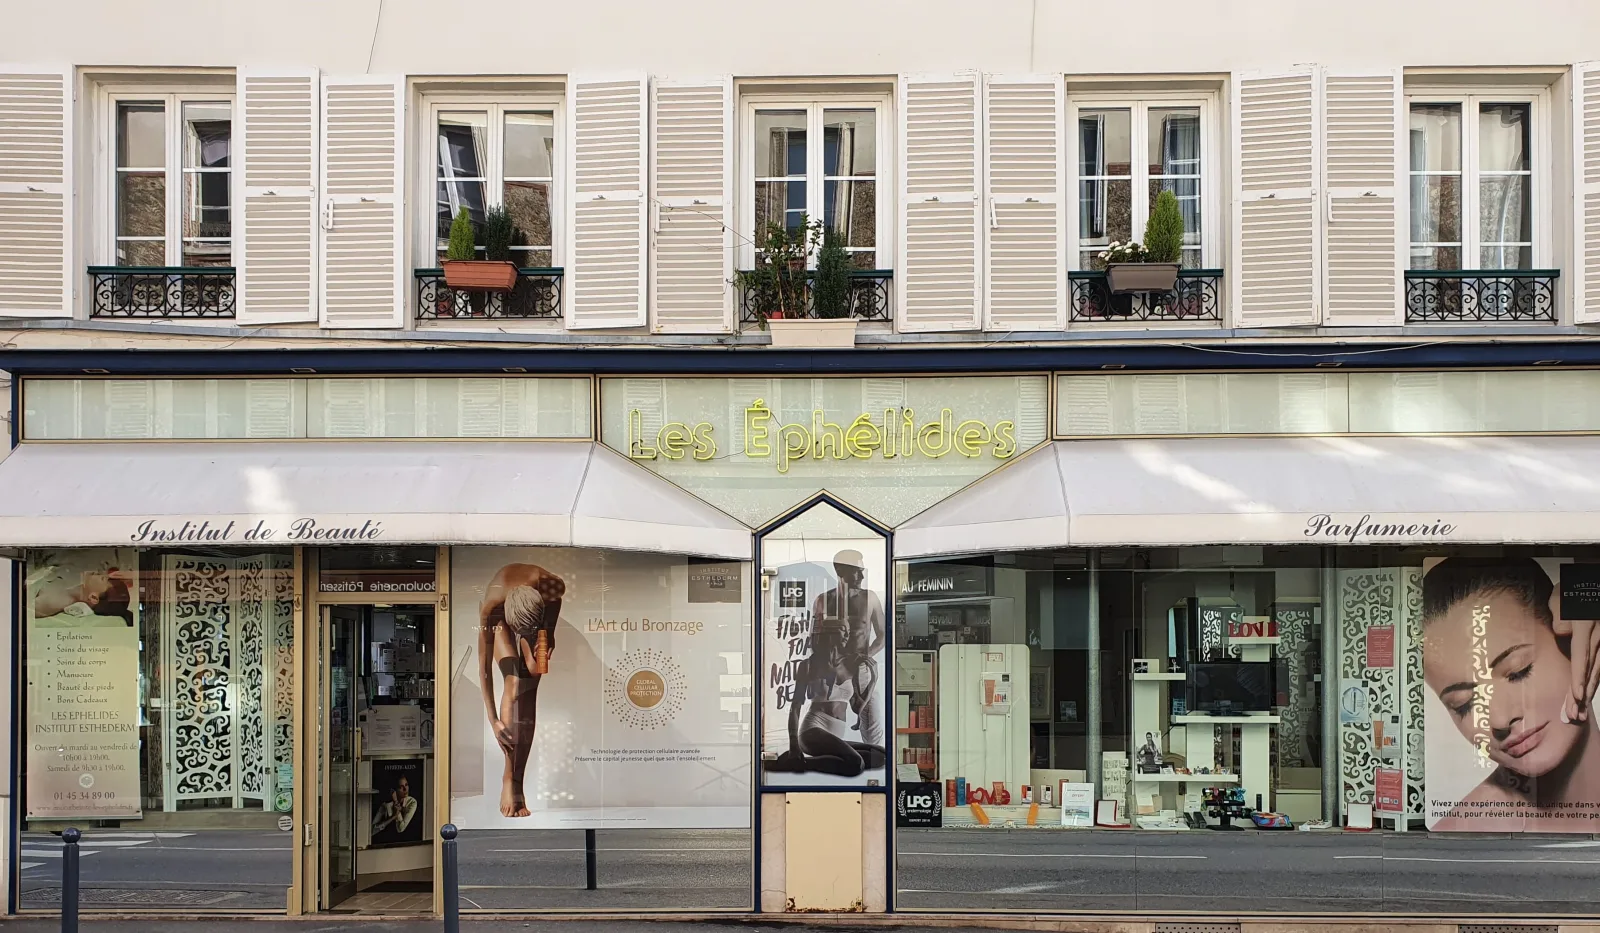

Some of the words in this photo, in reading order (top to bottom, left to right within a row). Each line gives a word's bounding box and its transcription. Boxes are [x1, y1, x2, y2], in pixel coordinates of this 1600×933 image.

[628, 408, 717, 461] Les
[744, 398, 1018, 473] Éphélides
[130, 519, 235, 542] Institut
[244, 519, 277, 540] de
[287, 517, 385, 540] Beauté
[1304, 513, 1457, 542] Parfumerie
[901, 580, 914, 593] AU
[918, 577, 954, 592] FEMININ
[782, 587, 803, 598] LPG
[588, 618, 617, 632] L'Art
[620, 617, 638, 632] du
[642, 618, 704, 635] Bronzage
[1229, 621, 1280, 638] LOVE
[56, 631, 93, 641] Epilations
[56, 643, 75, 653] Soins
[77, 643, 87, 653] du
[88, 645, 110, 654] visage
[56, 656, 75, 666] Soins
[77, 656, 87, 665] du
[88, 659, 107, 667] corps
[57, 681, 81, 691] Beauté
[83, 681, 94, 691] des
[96, 681, 115, 692] pieds
[57, 694, 74, 704] Bons
[76, 694, 108, 704] Cadeaux
[51, 711, 67, 721] LES
[69, 710, 120, 720] EPHELIDES
[35, 723, 78, 733] INSTITUT
[79, 723, 136, 733] ESTHEDERM
[69, 743, 89, 751] mardi
[99, 743, 131, 751] vendredi
[590, 748, 621, 756] Technologie
[629, 748, 655, 756] protection
[602, 755, 620, 763] capital
[620, 755, 643, 763] jeunesse
[643, 755, 655, 763] quel
[53, 791, 63, 800] 01
[66, 791, 77, 800] 45
[79, 791, 89, 800] 34
[92, 791, 102, 800] 89
[104, 791, 115, 800] 00
[907, 795, 933, 808] LPG
[1471, 800, 1514, 809] expérience
[1432, 810, 1462, 818] institut,
